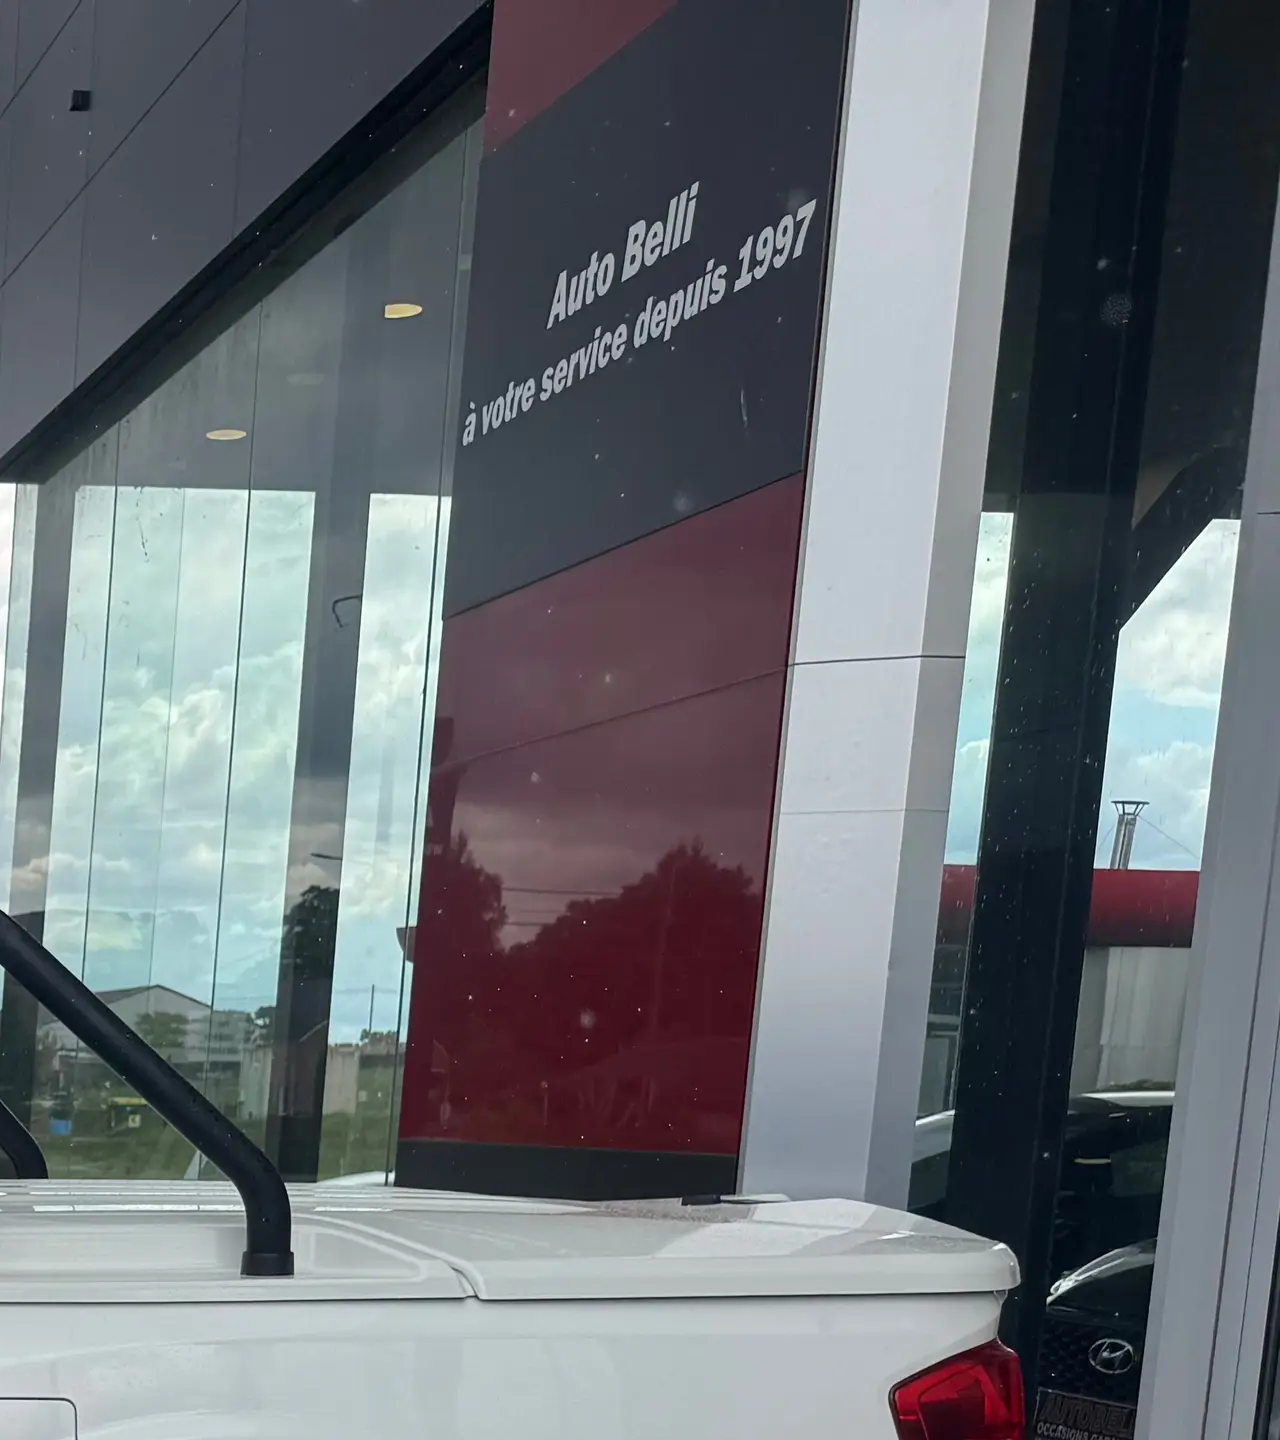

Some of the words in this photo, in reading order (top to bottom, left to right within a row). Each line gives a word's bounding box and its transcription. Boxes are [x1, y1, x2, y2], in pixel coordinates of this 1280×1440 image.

[462, 401, 477, 446] à
[482, 378, 536, 435] votre
[540, 325, 628, 401] service
[633, 258, 728, 348] depuis
[732, 199, 817, 293] 1997
[547, 269, 615, 329] Auto
[621, 181, 700, 283] Belli
